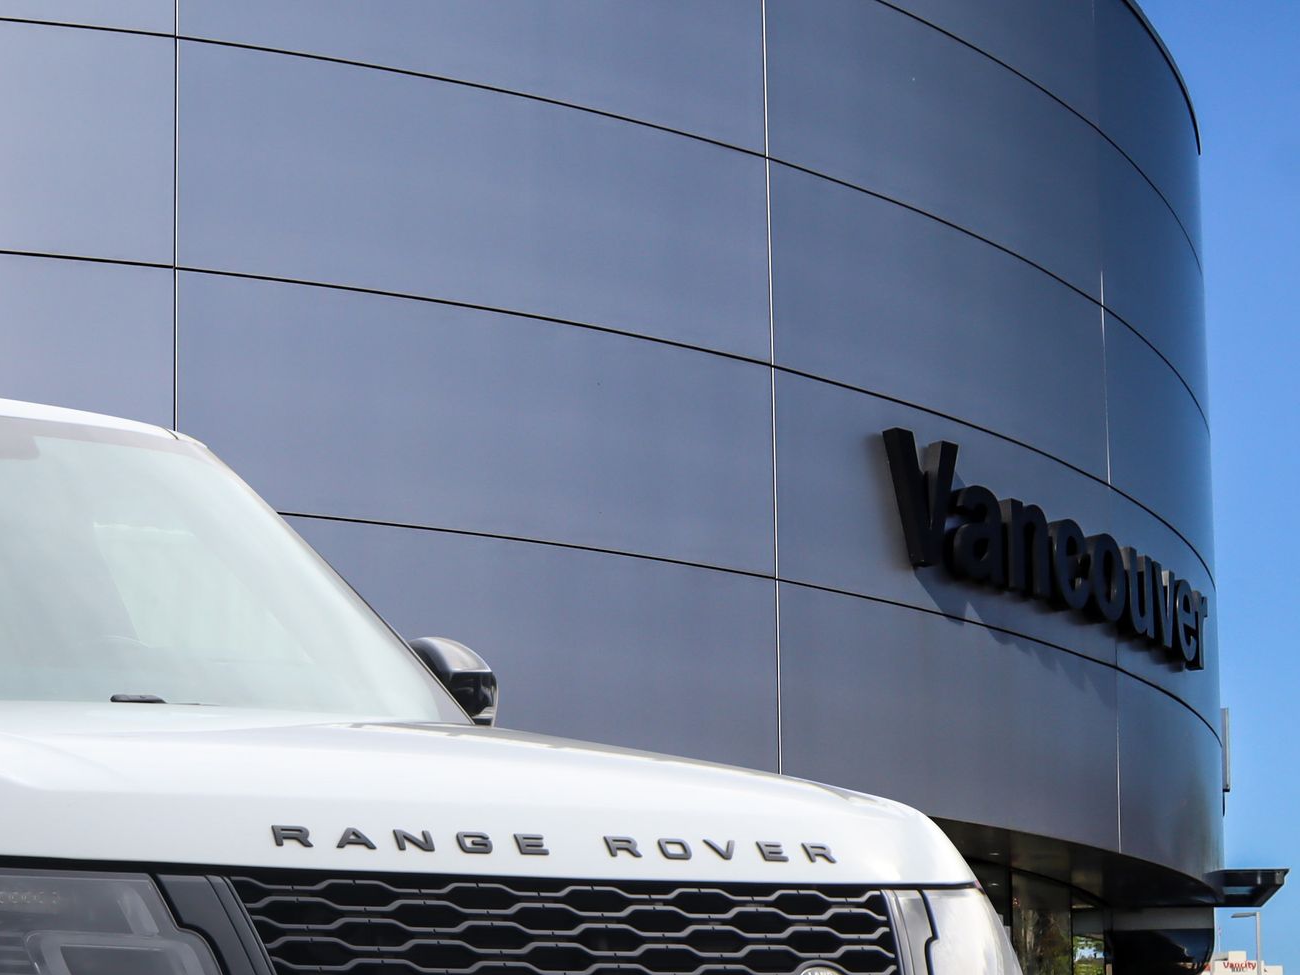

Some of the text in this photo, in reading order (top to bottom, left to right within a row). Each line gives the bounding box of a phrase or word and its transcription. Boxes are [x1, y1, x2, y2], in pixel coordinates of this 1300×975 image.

[882, 427, 1208, 671] Vancouver
[271, 824, 838, 864] RANGE ROVER
[1223, 961, 1257, 970] Vancity
